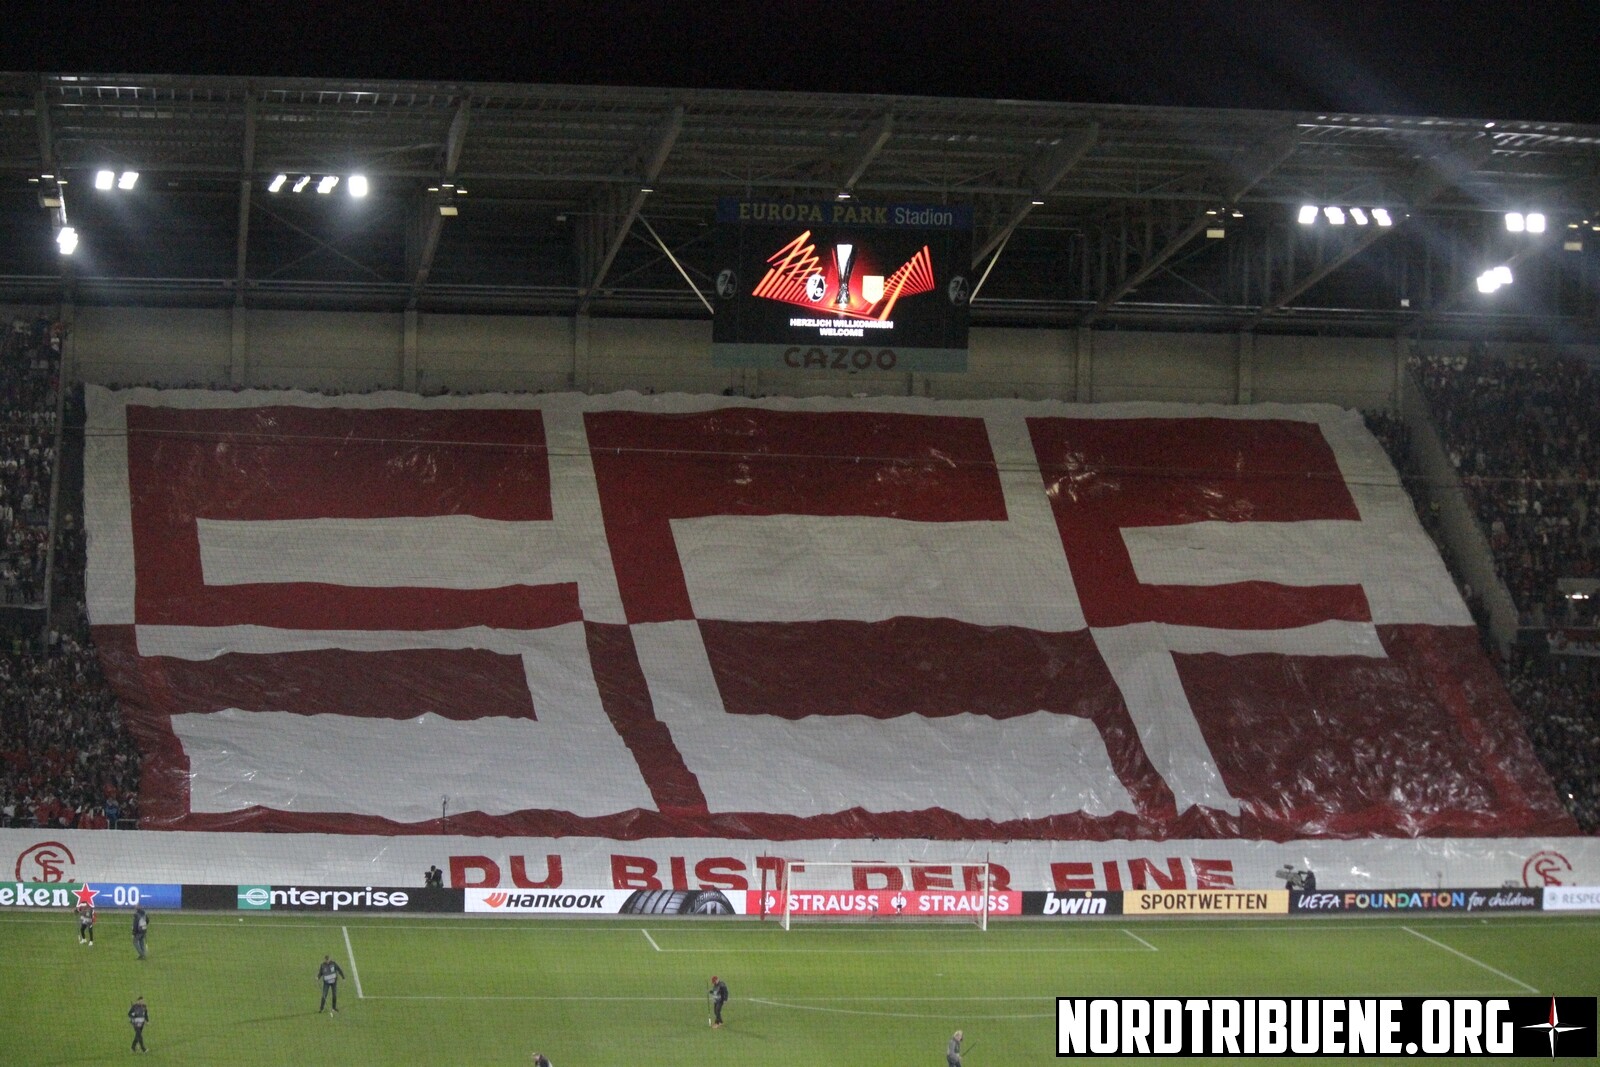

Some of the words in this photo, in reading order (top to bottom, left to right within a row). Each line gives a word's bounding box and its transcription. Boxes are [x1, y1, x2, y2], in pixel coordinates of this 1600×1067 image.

[738, 203, 823, 221] EUROPA
[832, 205, 888, 224] PARK
[895, 207, 953, 226] Stadion
[790, 318, 832, 328] HERZLICH
[833, 319, 893, 329] WILLKOMMEN
[819, 328, 864, 337] WELCOME
[784, 348, 897, 370] CAZOO
[449, 854, 563, 889] DU
[610, 853, 805, 890] BIST
[852, 859, 1011, 891] DER
[1050, 857, 1235, 891] EINE
[238, 887, 410, 911] enterprise
[788, 895, 879, 911] STRAUSS
[918, 895, 1009, 911] STRAUSS
[1043, 891, 1107, 914] bwin
[1140, 893, 1268, 910] SPORTWETTEN
[1298, 894, 1341, 909] UEFA
[1344, 892, 1464, 908] FOUNDATION
[1467, 891, 1486, 911] for
[1488, 892, 1535, 907] children
